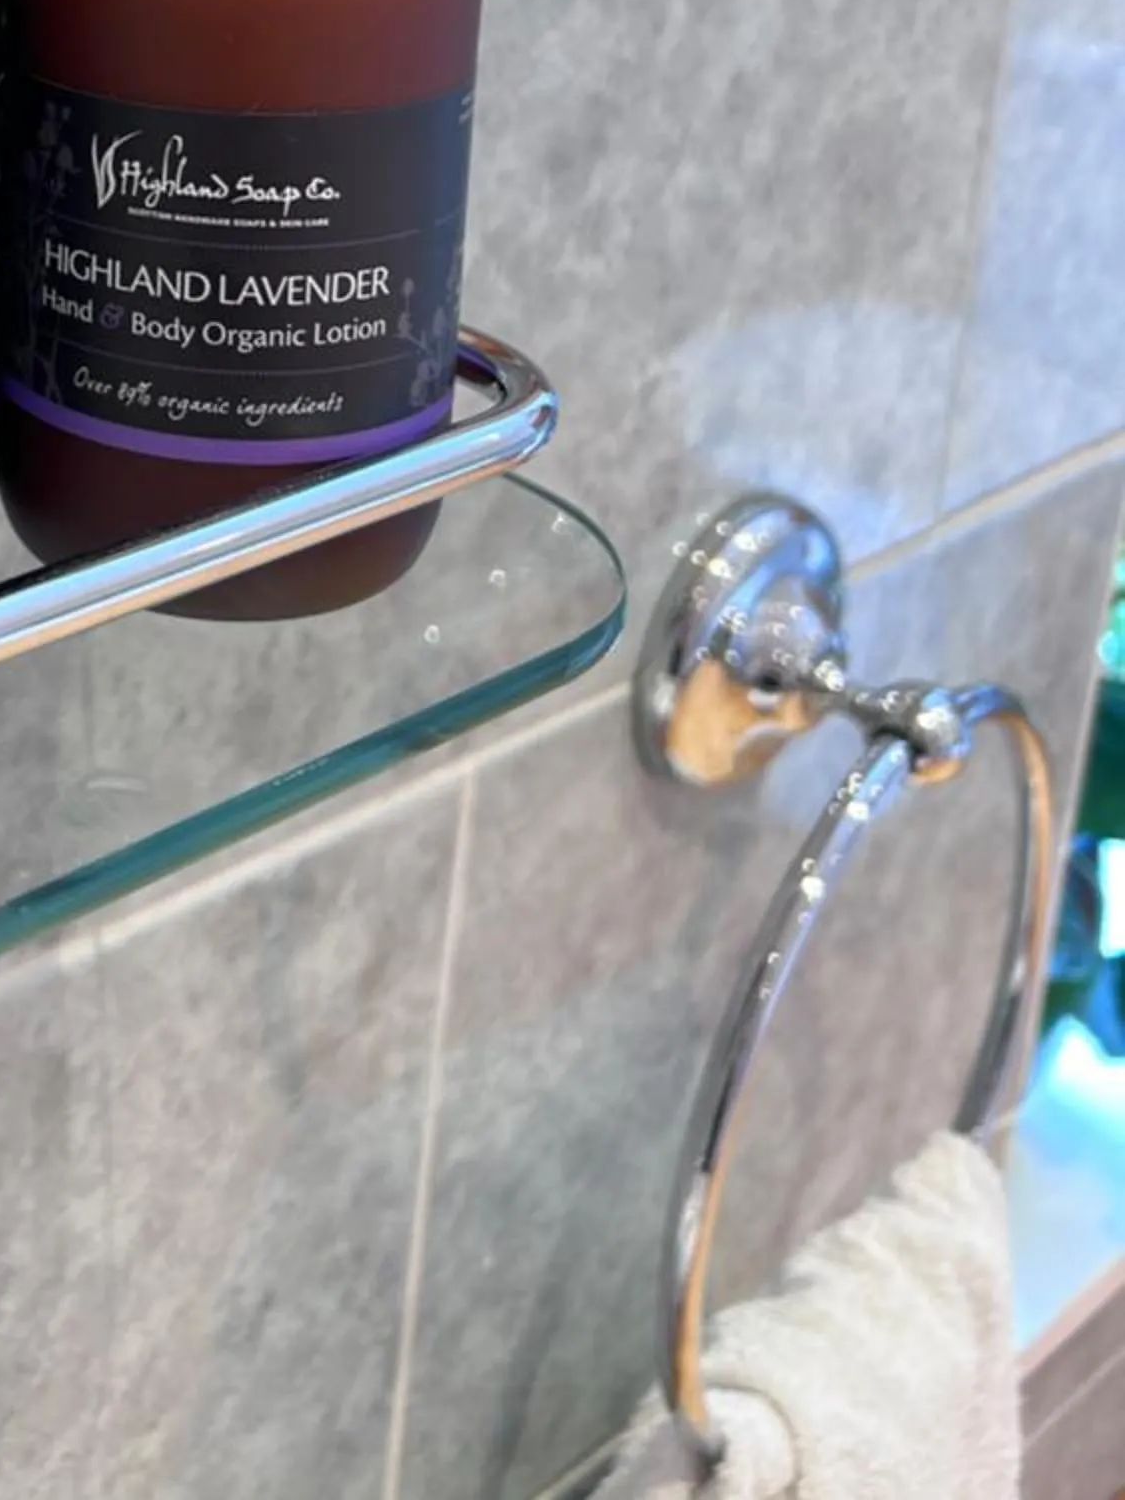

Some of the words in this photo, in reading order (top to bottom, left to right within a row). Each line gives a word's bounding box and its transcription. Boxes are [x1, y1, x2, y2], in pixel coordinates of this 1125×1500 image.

[120, 134, 229, 208] Highland
[231, 174, 301, 217] Soap
[305, 176, 341, 200] Co.
[44, 239, 211, 302] HIGHLAND
[218, 265, 391, 307] LAVENDER
[41, 285, 93, 323] Hand
[99, 302, 124, 329] &
[131, 311, 196, 348] Body
[202, 321, 306, 354] Organic
[313, 317, 387, 346] Lotion
[73, 365, 112, 396] Over
[158, 395, 230, 421] organic
[236, 392, 345, 427] ingredients
